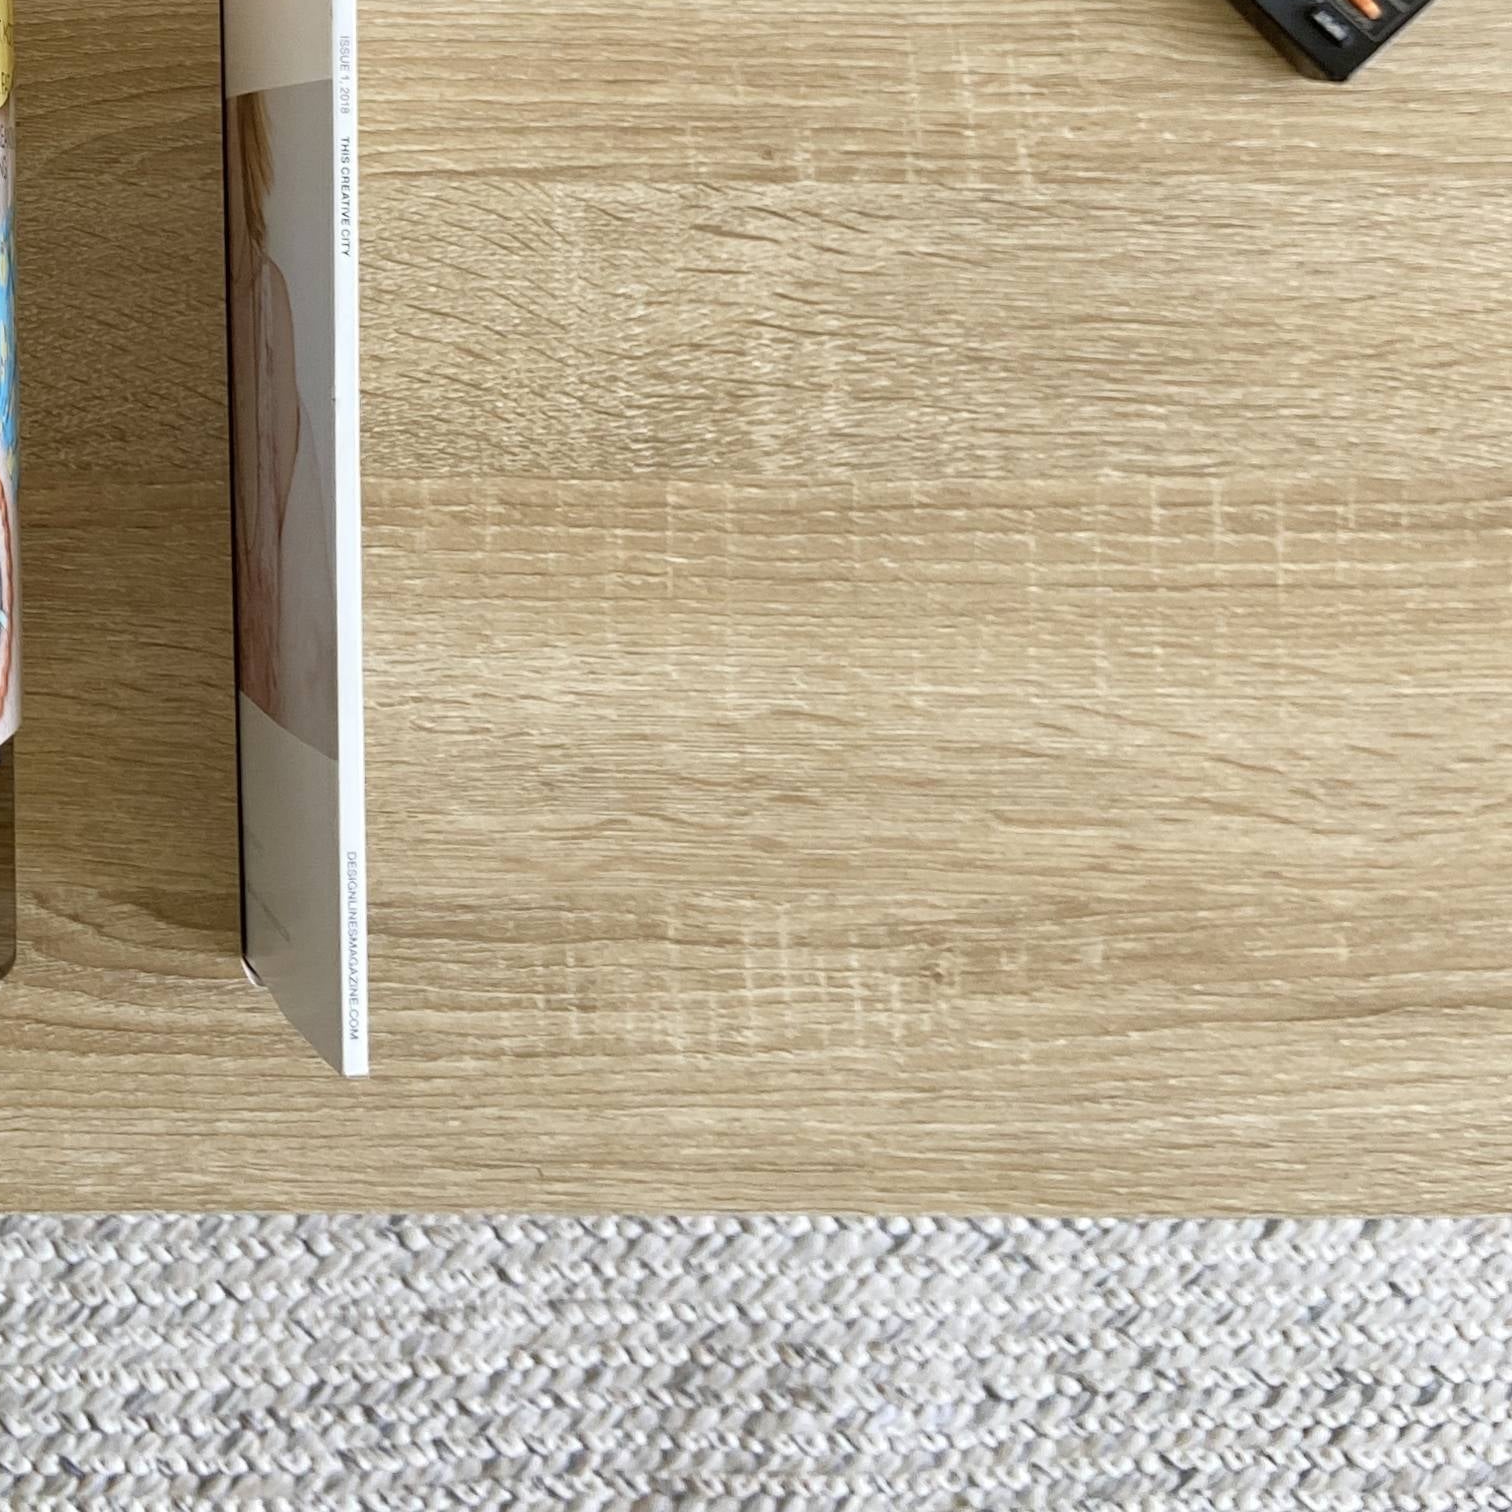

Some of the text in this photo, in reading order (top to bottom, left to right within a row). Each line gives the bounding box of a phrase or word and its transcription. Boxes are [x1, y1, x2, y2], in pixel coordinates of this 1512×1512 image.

[339, 35, 351, 72] ISSUE
[340, 87, 351, 115] 2018
[341, 136, 351, 164] THIS
[341, 165, 351, 227] CREATIVE
[341, 228, 352, 257] CITY
[346, 851, 360, 1041] DESIGNLINESMAGAZINE.COM
